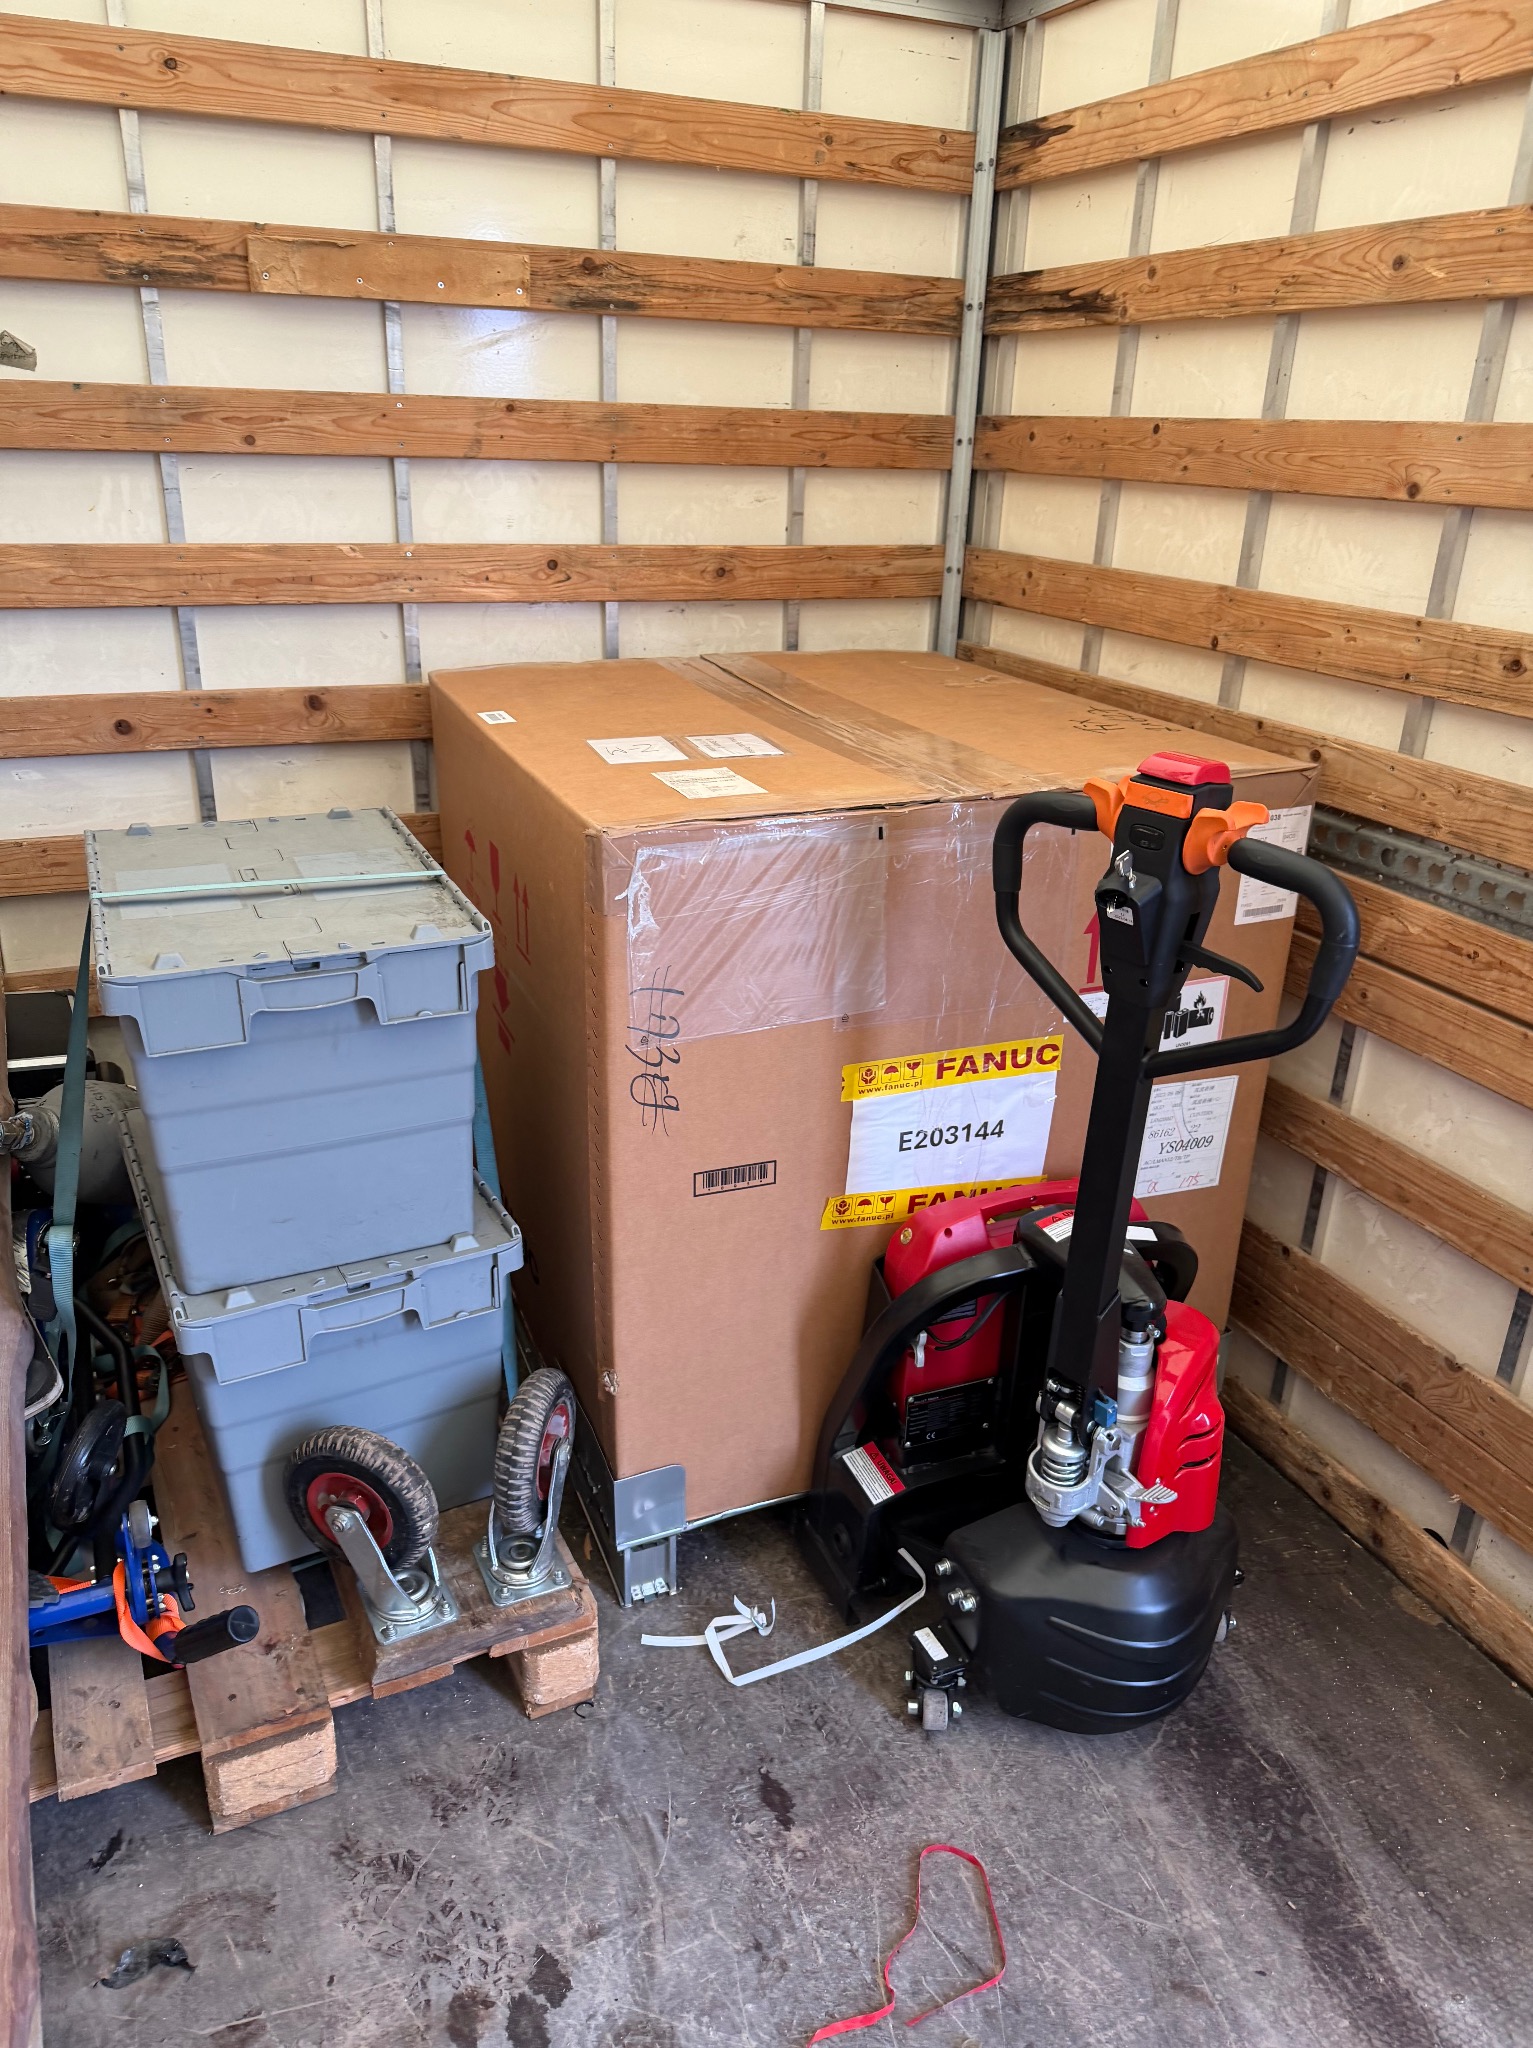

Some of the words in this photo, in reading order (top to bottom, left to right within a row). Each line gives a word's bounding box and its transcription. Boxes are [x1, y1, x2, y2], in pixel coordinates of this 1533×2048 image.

[936, 1043, 1060, 1080] FANUC
[858, 1080, 923, 1095] www.fanuc.pl
[899, 1119, 1005, 1153] E203144
[1158, 1135, 1214, 1155] YS04009
[907, 1184, 1022, 1214] FAN
[831, 1213, 894, 1226] www.fanuc.pl
